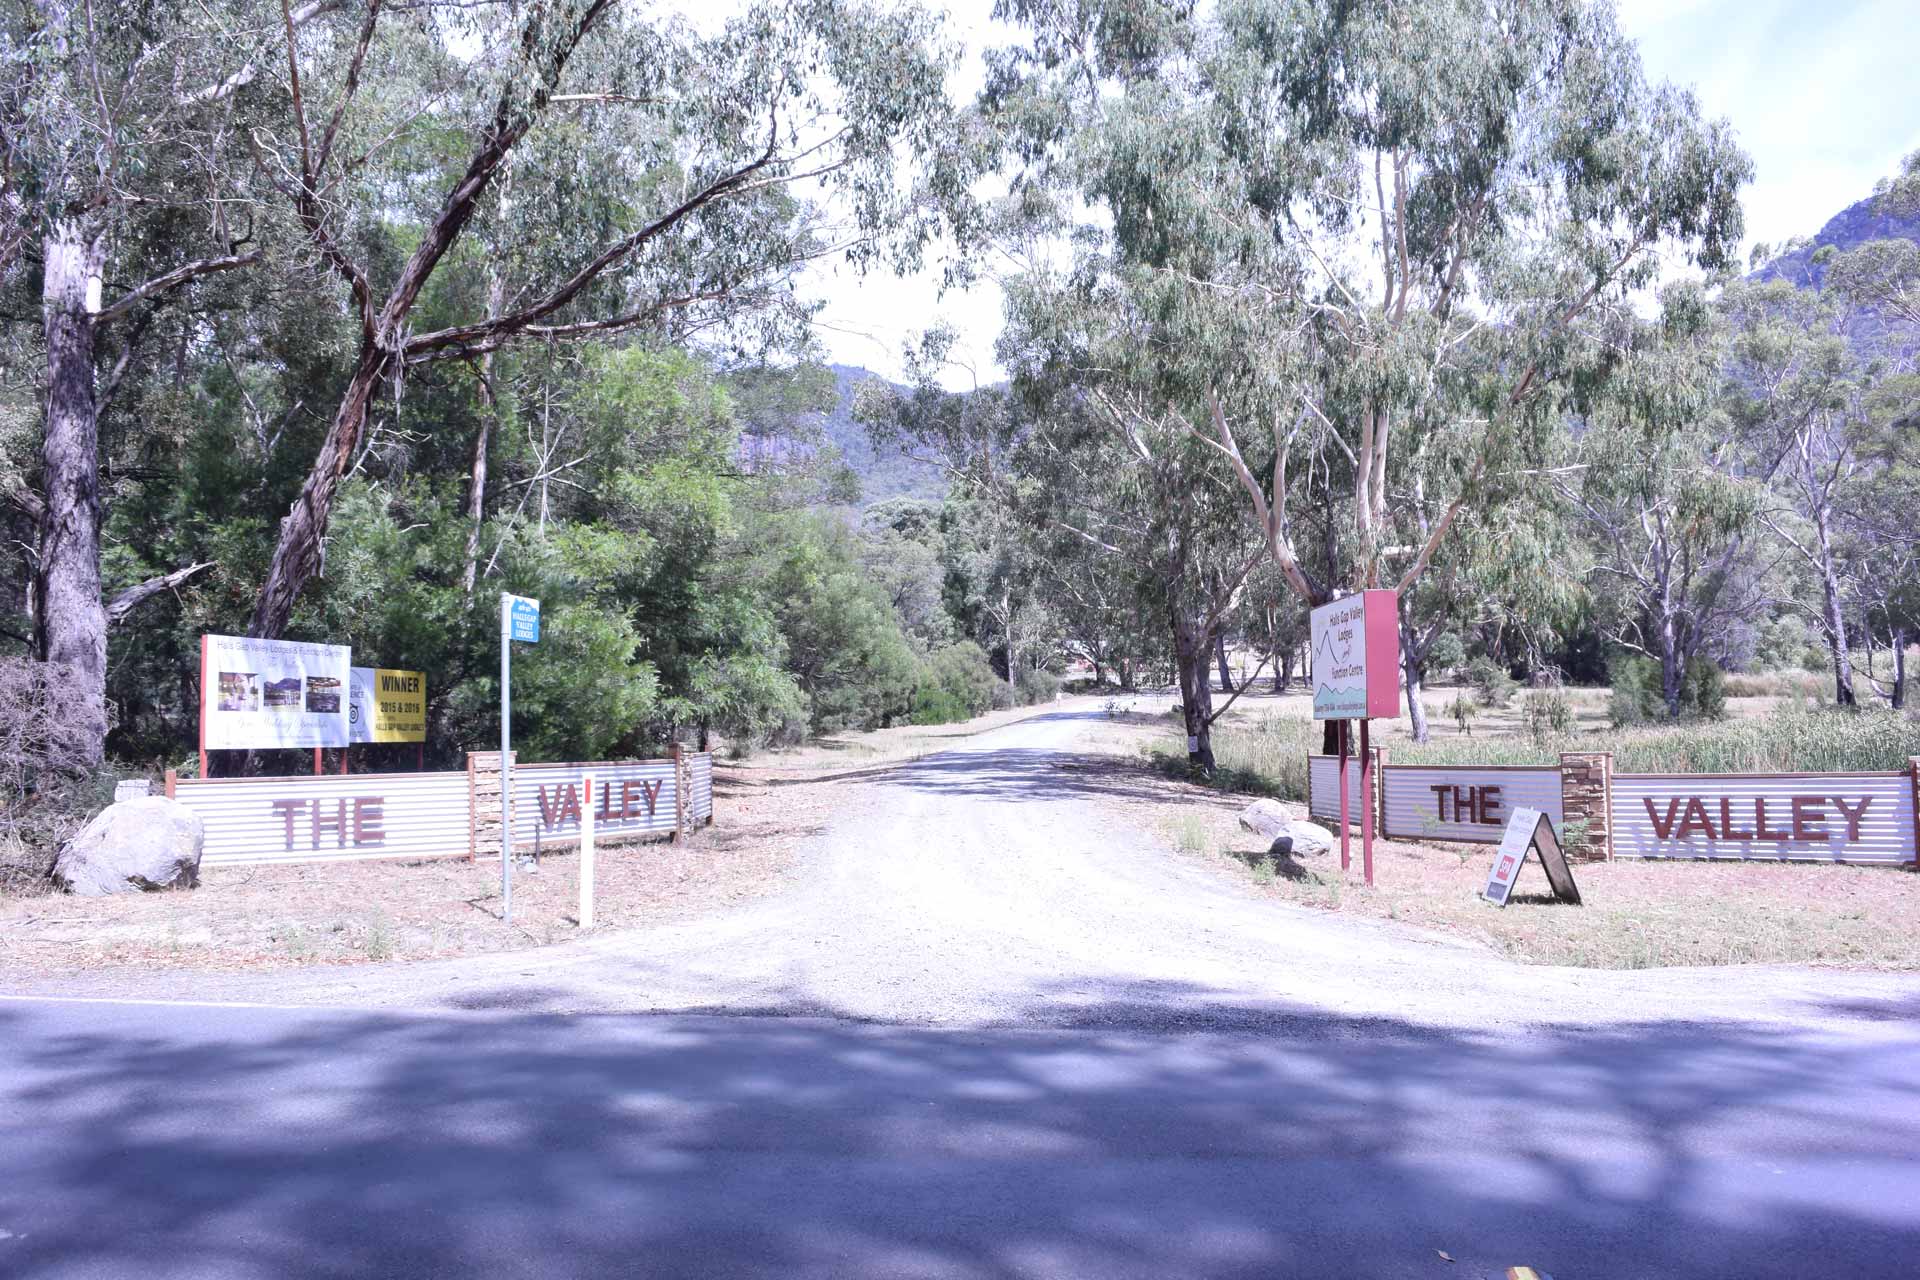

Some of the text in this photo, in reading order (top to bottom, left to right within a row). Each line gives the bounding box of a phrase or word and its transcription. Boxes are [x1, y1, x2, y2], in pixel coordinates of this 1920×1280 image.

[1330, 607, 1363, 626] Halls Gap Valley
[1338, 627, 1353, 644] Lodges
[381, 675, 420, 693] WINNER
[380, 701, 396, 713] 2015
[272, 779, 663, 851] THE VALEY
[1430, 784, 1502, 825] THE
[1642, 796, 1872, 842] VALLEY
